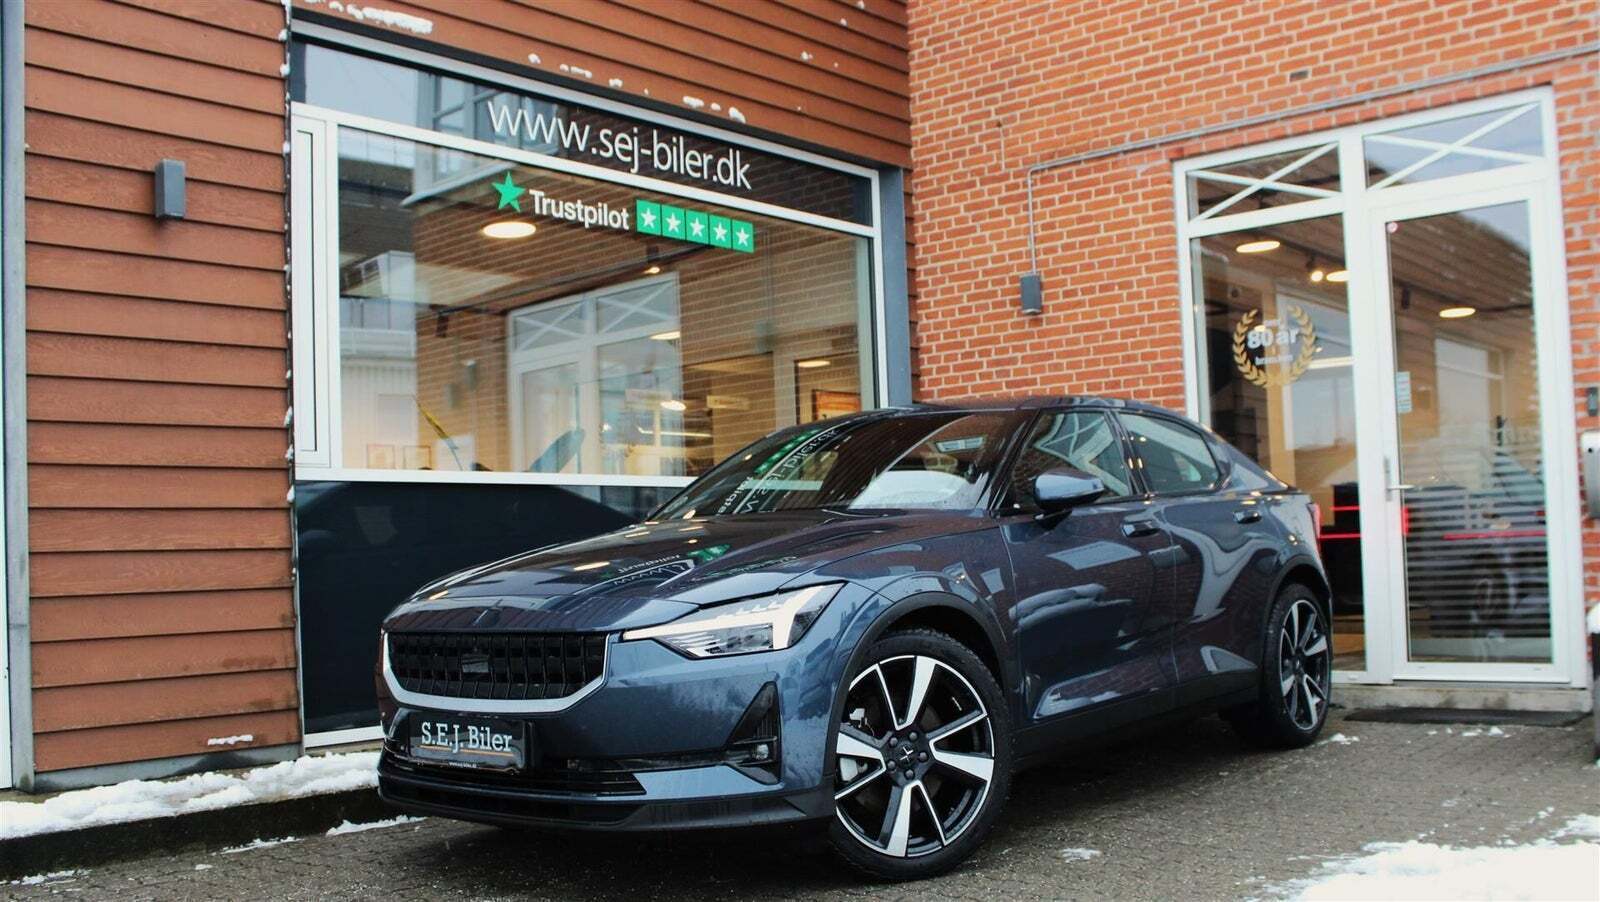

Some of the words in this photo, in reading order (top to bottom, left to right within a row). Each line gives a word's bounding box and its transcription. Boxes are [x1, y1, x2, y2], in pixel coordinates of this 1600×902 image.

[487, 101, 752, 190] www.sej-biler.dk
[529, 189, 630, 231] Trustpilot
[1247, 330, 1274, 349] 80
[421, 721, 464, 754] S.E.J.
[467, 725, 513, 752] Biler
